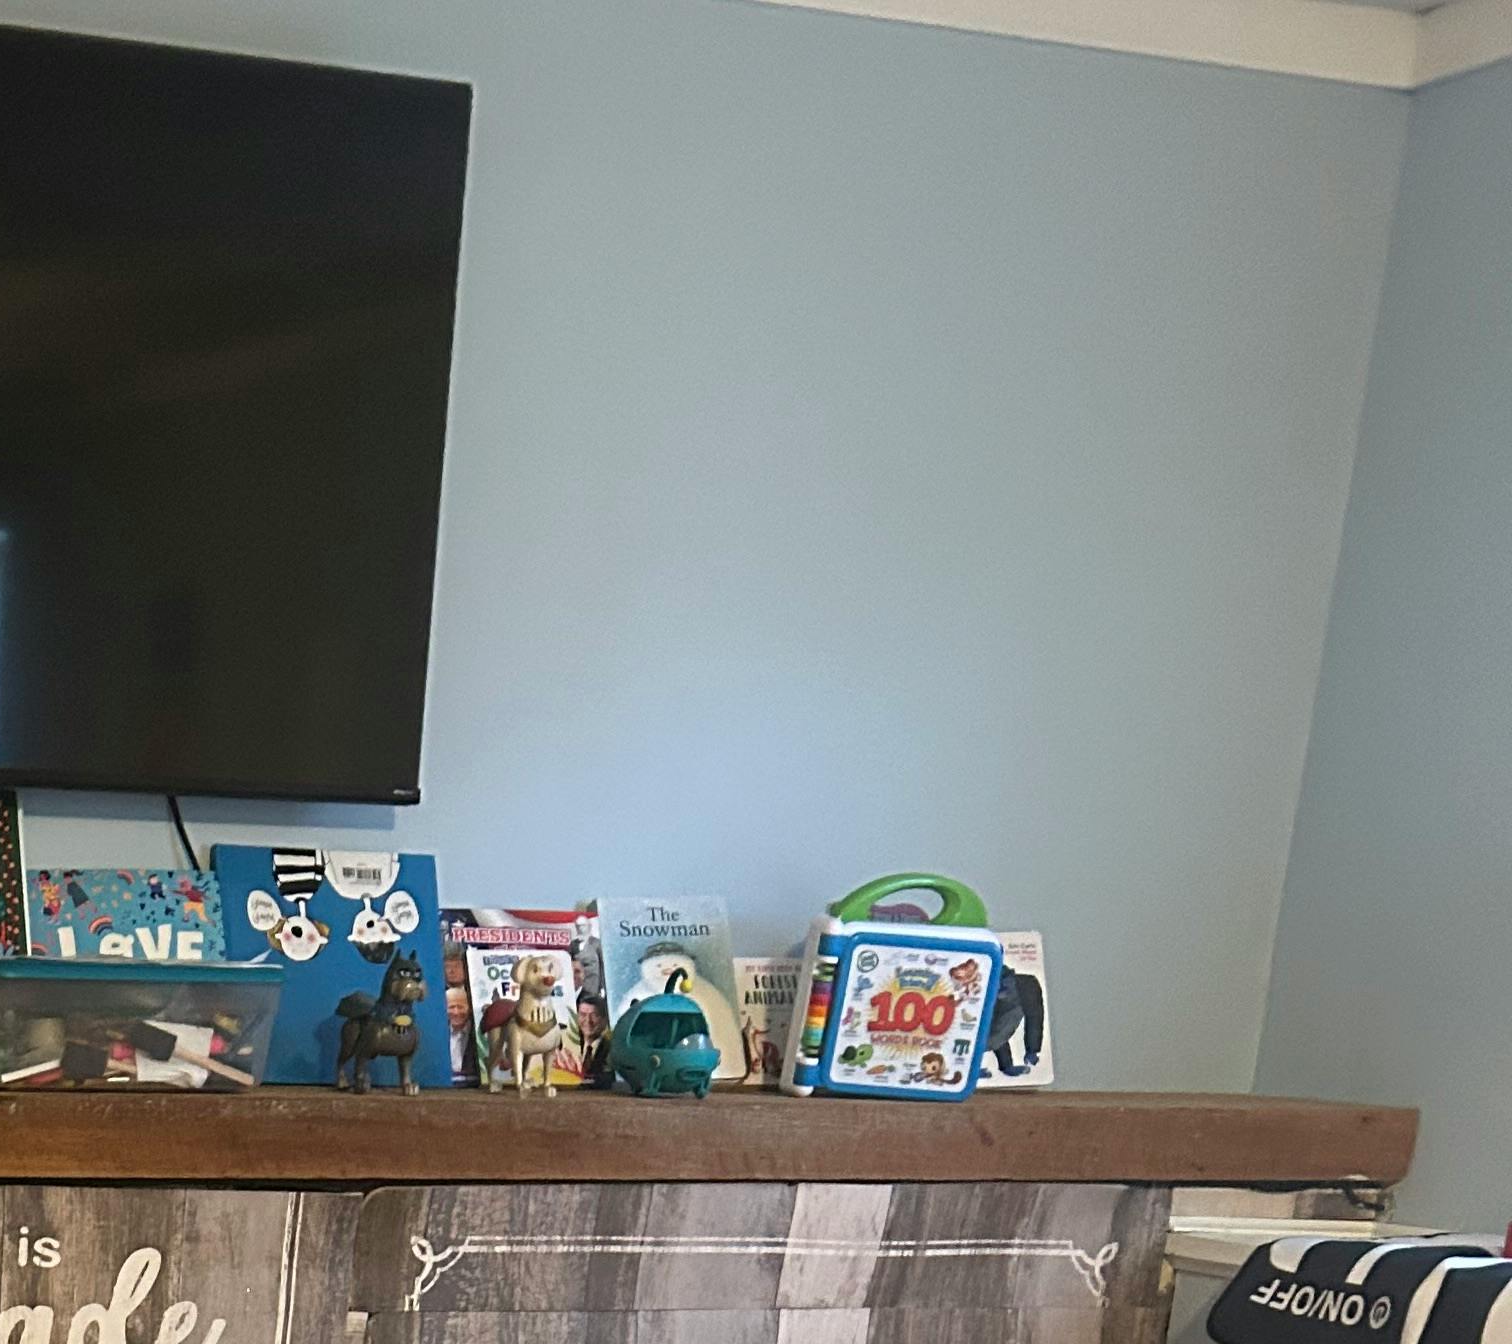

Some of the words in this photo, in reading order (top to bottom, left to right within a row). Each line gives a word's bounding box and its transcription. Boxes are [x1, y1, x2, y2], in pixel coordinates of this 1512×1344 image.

[618, 919, 711, 938] Snowman
[646, 905, 680, 924] The
[452, 927, 571, 946] PRESIDENTS
[866, 990, 956, 1036] 100
[16, 1224, 64, 1269] is
[1249, 1278, 1365, 1327] ON/OFF
